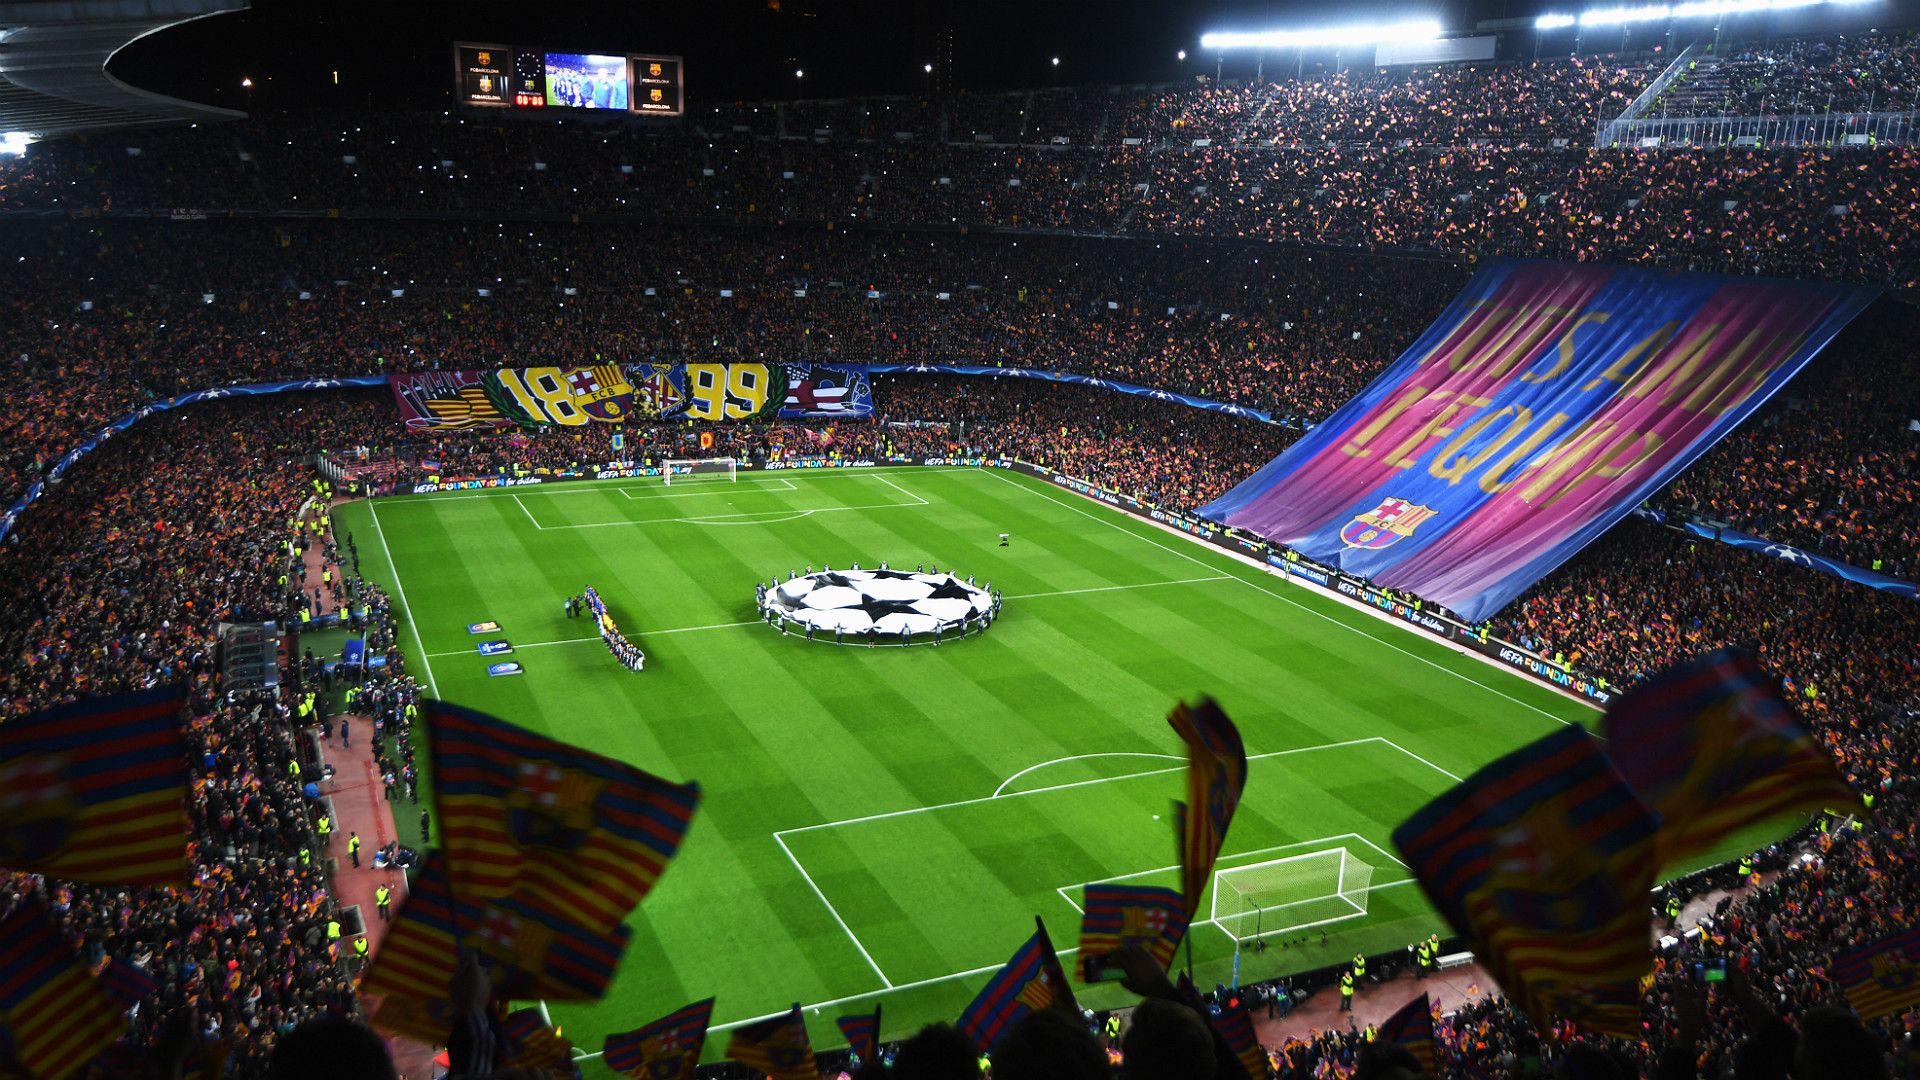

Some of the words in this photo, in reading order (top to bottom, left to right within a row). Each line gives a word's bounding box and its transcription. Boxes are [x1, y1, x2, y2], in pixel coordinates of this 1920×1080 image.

[496, 366, 589, 426] 18
[684, 363, 770, 421] 99
[591, 387, 616, 401] FCB
[765, 460, 785, 470] UEFA
[786, 459, 842, 468] FOUNDATION
[924, 457, 945, 466] UEFA
[597, 470, 619, 479] UEFA
[413, 483, 438, 494] UEFA
[439, 478, 504, 490] FOUNDATION
[505, 477, 517, 487] for
[517, 477, 542, 486] children
[1150, 510, 1165, 521] UEFA
[1307, 569, 1326, 582] LEAGUE
[1338, 581, 1356, 596] UEFA
[1357, 589, 1412, 619] FOUNDATION
[1411, 611, 1421, 622] for
[1421, 616, 1445, 633] children
[1499, 647, 1524, 666] UEFA
